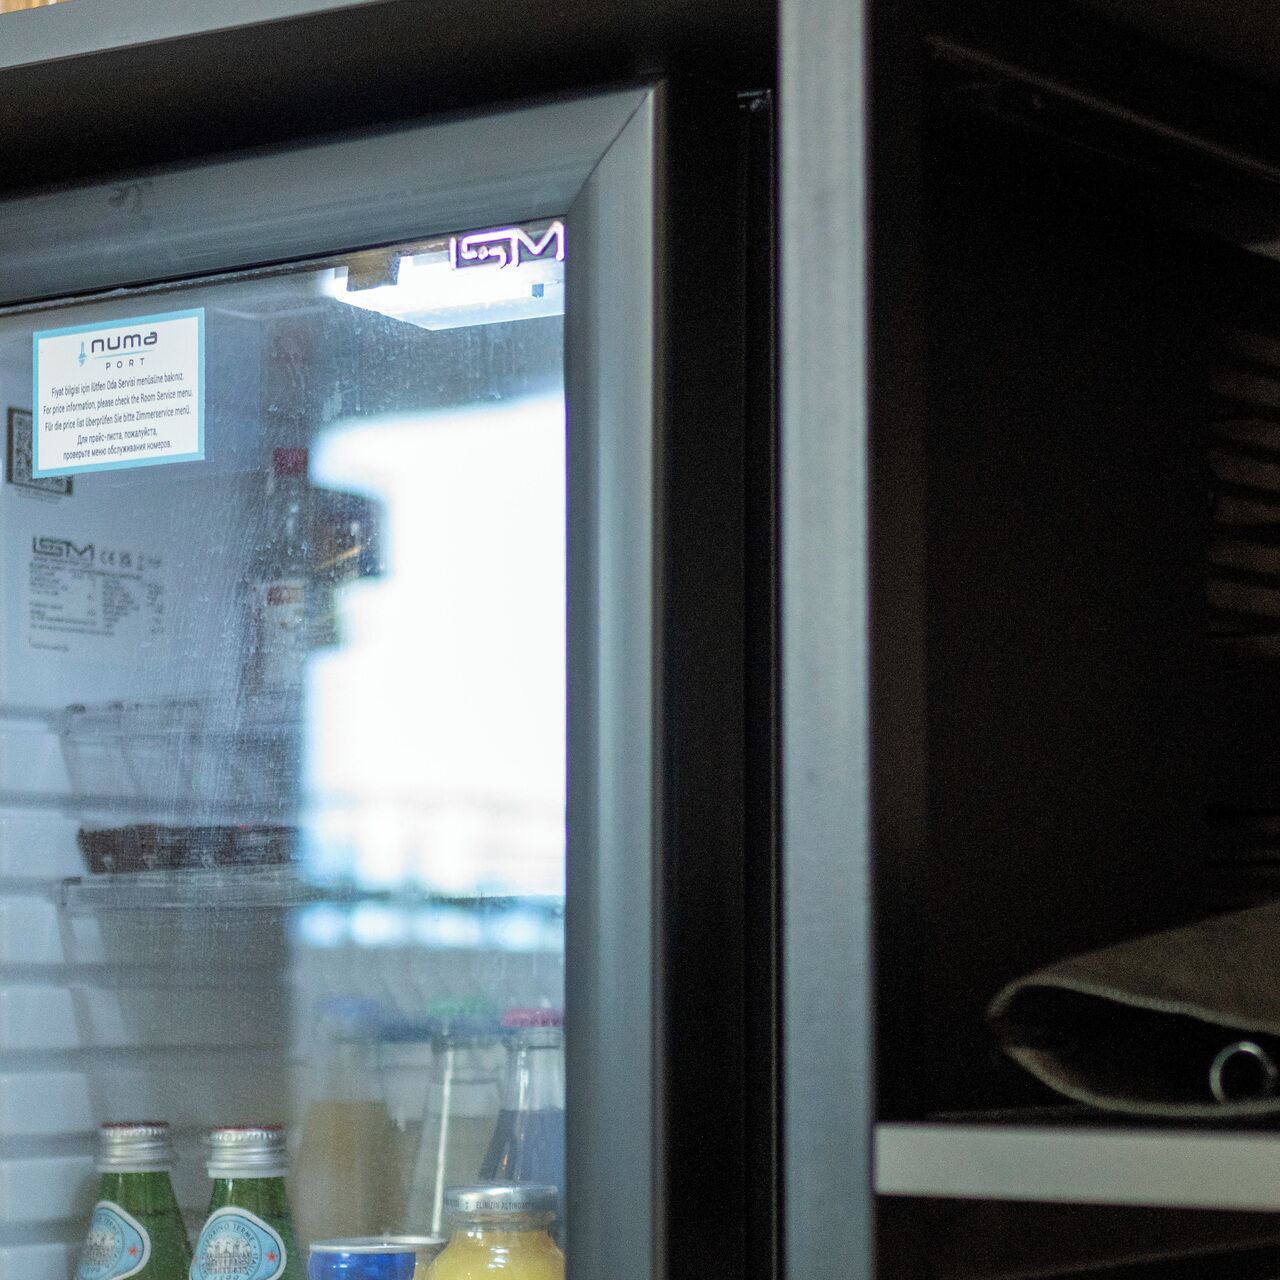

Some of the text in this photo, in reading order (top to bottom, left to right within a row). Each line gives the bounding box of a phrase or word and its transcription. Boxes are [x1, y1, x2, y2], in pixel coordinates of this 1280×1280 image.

[91, 331, 158, 353] numa
[105, 357, 144, 370] PORT
[51, 386, 64, 398] Fiyat
[107, 379, 117, 390] Oda
[118, 376, 135, 389] Servisi
[43, 405, 51, 415] For
[52, 403, 65, 416] price
[97, 397, 113, 411] please
[115, 395, 130, 406] check
[131, 393, 140, 404] the
[140, 392, 155, 403] Room
[157, 390, 176, 401] Service
[45, 421, 54, 432] Für
[54, 420, 62, 431] die
[63, 418, 75, 432] price
[76, 418, 85, 428] list
[86, 414, 113, 428] überprüfen
[114, 413, 122, 424] Sie
[123, 411, 135, 423] bitte
[136, 407, 174, 421] Zimmerservice
[77, 434, 88, 446] Для
[124, 427, 157, 440] пожалуйста,
[63, 449, 90, 461] проверьте
[91, 447, 106, 457] меню
[107, 443, 146, 456] обслуживания
